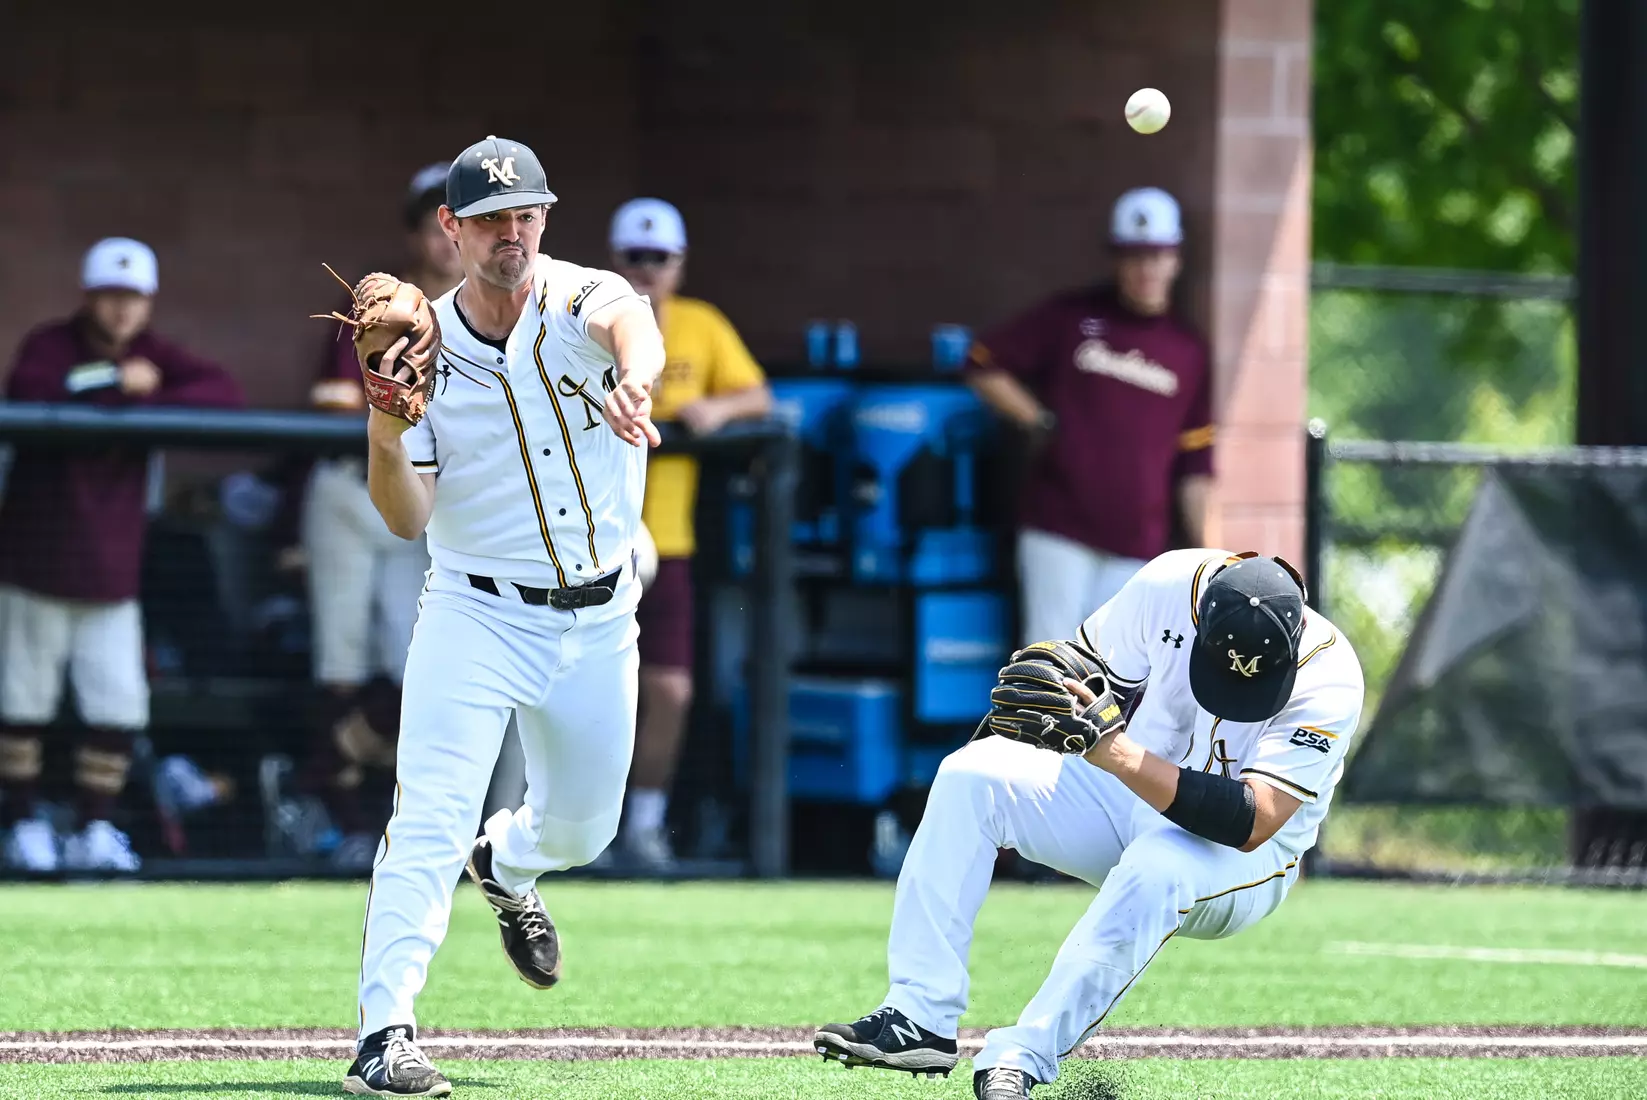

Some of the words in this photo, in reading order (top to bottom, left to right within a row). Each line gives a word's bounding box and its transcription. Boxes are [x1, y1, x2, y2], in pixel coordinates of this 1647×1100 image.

[481, 156, 520, 186] M
[1228, 649, 1262, 677] M
[891, 1019, 922, 1047] N
[362, 1056, 384, 1081] N
